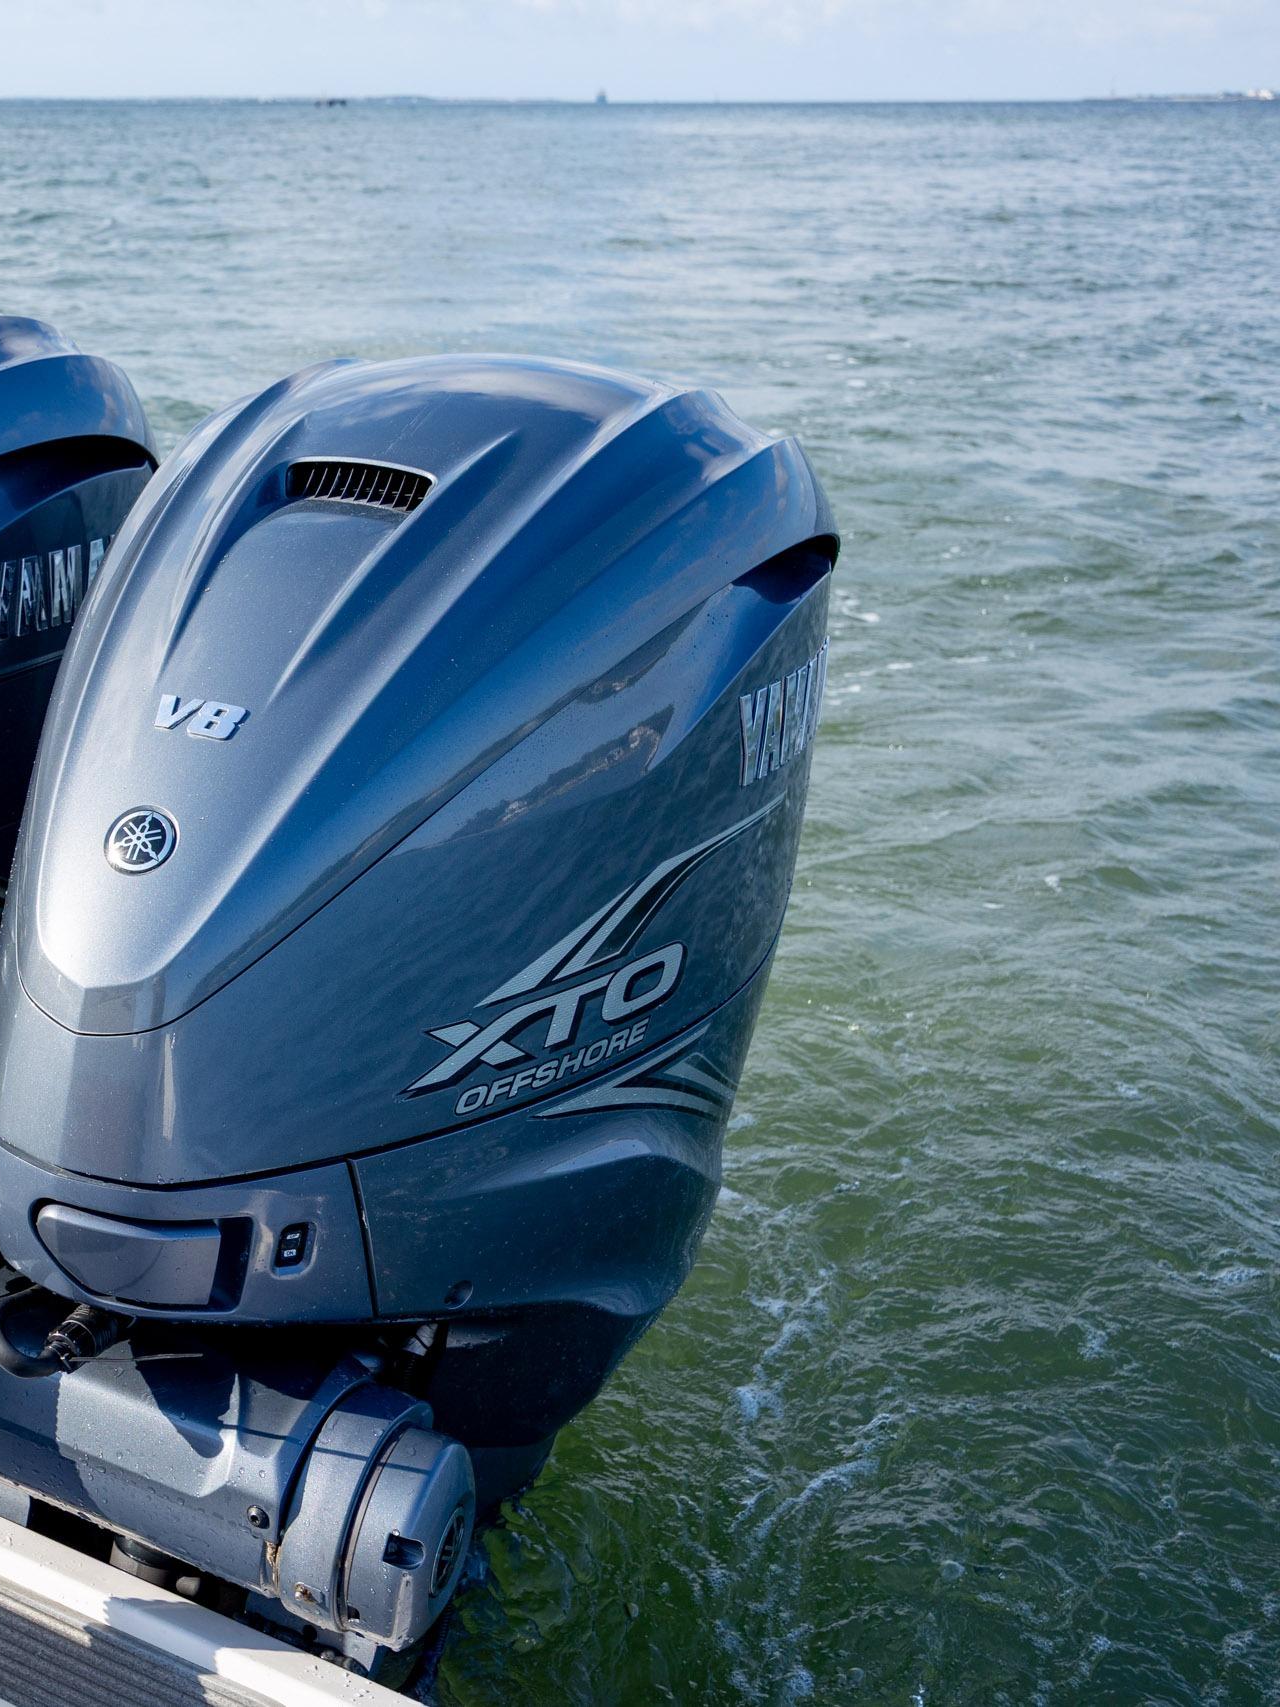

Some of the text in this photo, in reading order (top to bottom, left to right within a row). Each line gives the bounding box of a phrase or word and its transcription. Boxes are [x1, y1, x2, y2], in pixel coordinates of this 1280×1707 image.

[153, 693, 251, 741] V8
[400, 941, 689, 1094] XTO
[454, 1017, 651, 1116] OFFSHORE
